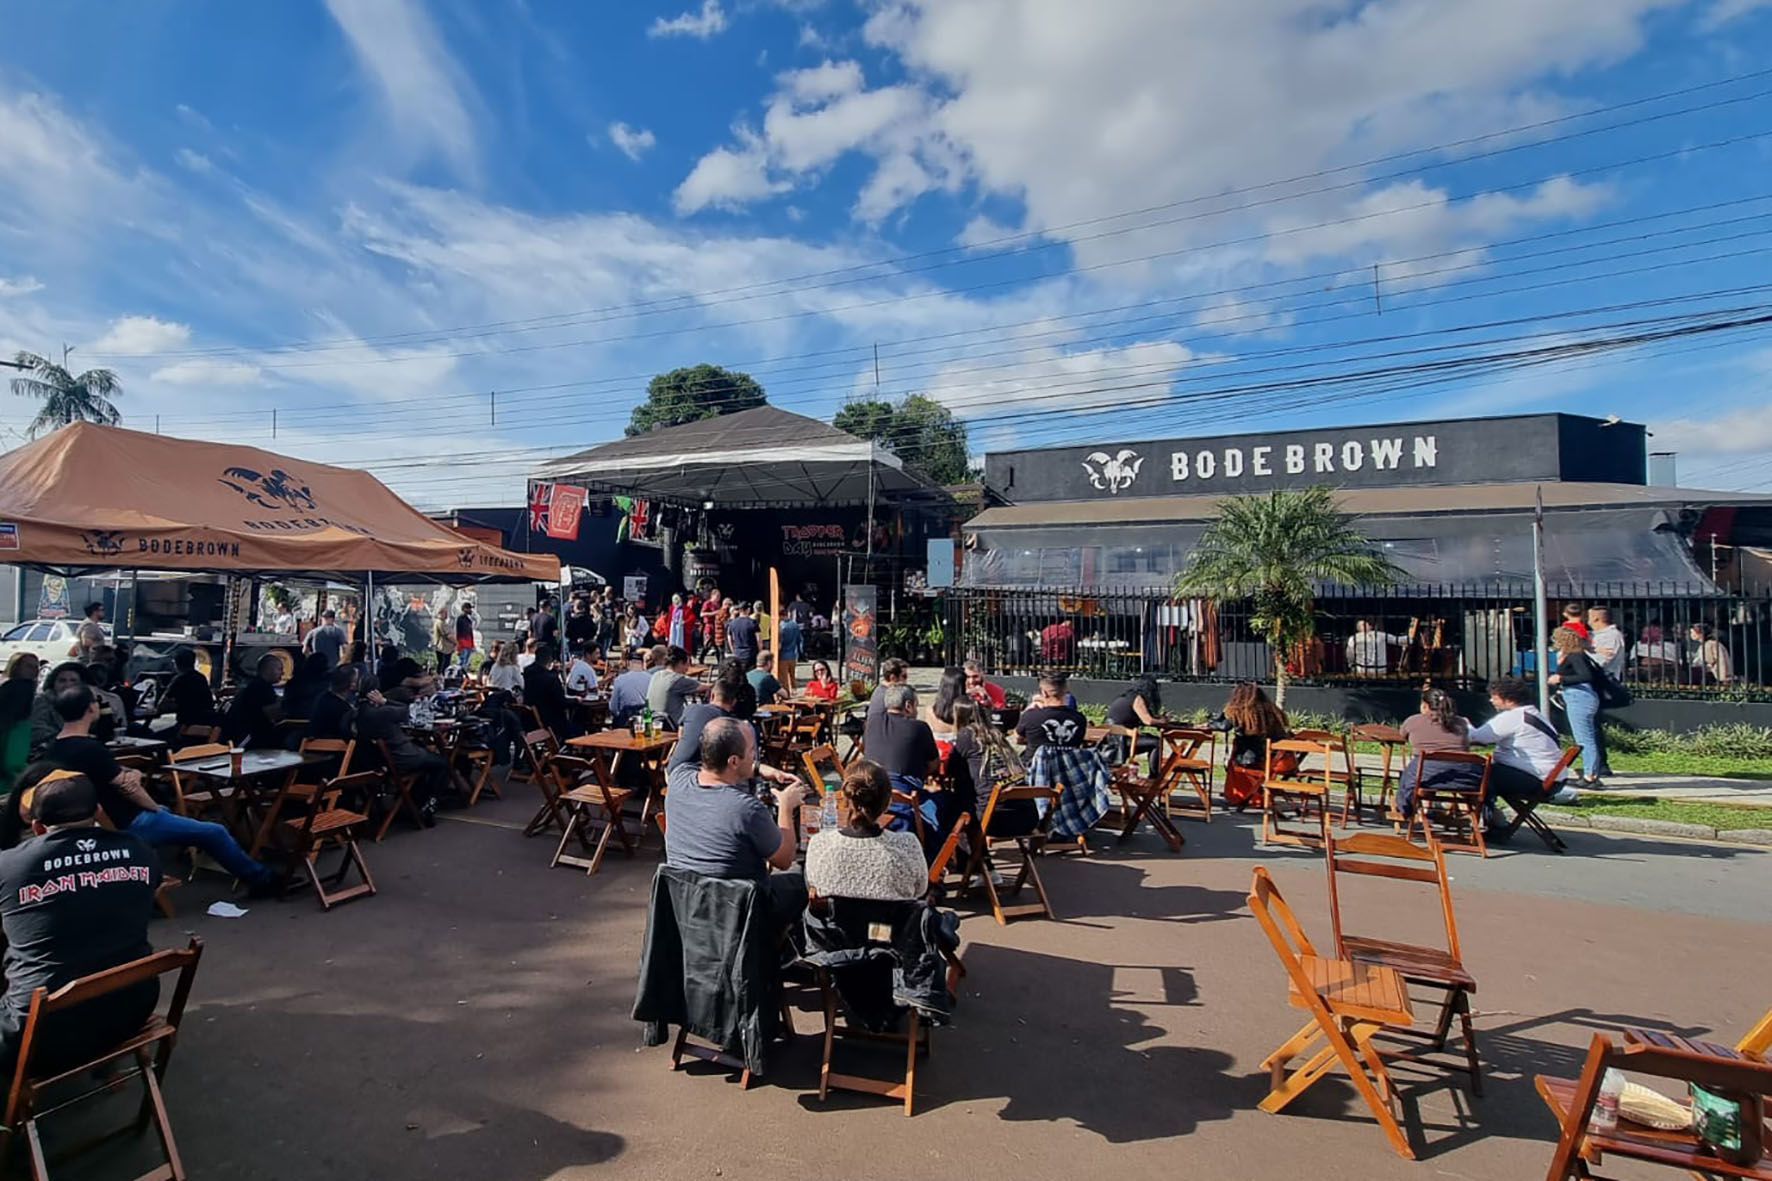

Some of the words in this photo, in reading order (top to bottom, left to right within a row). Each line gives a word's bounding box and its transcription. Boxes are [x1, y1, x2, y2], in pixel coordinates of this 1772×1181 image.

[1170, 436, 1438, 480] BODEBROWN
[138, 538, 240, 557] BODEBROWN
[44, 849, 130, 871] BODEBROWN
[19, 874, 76, 904] IRON
[78, 867, 150, 888] MAIDEN
